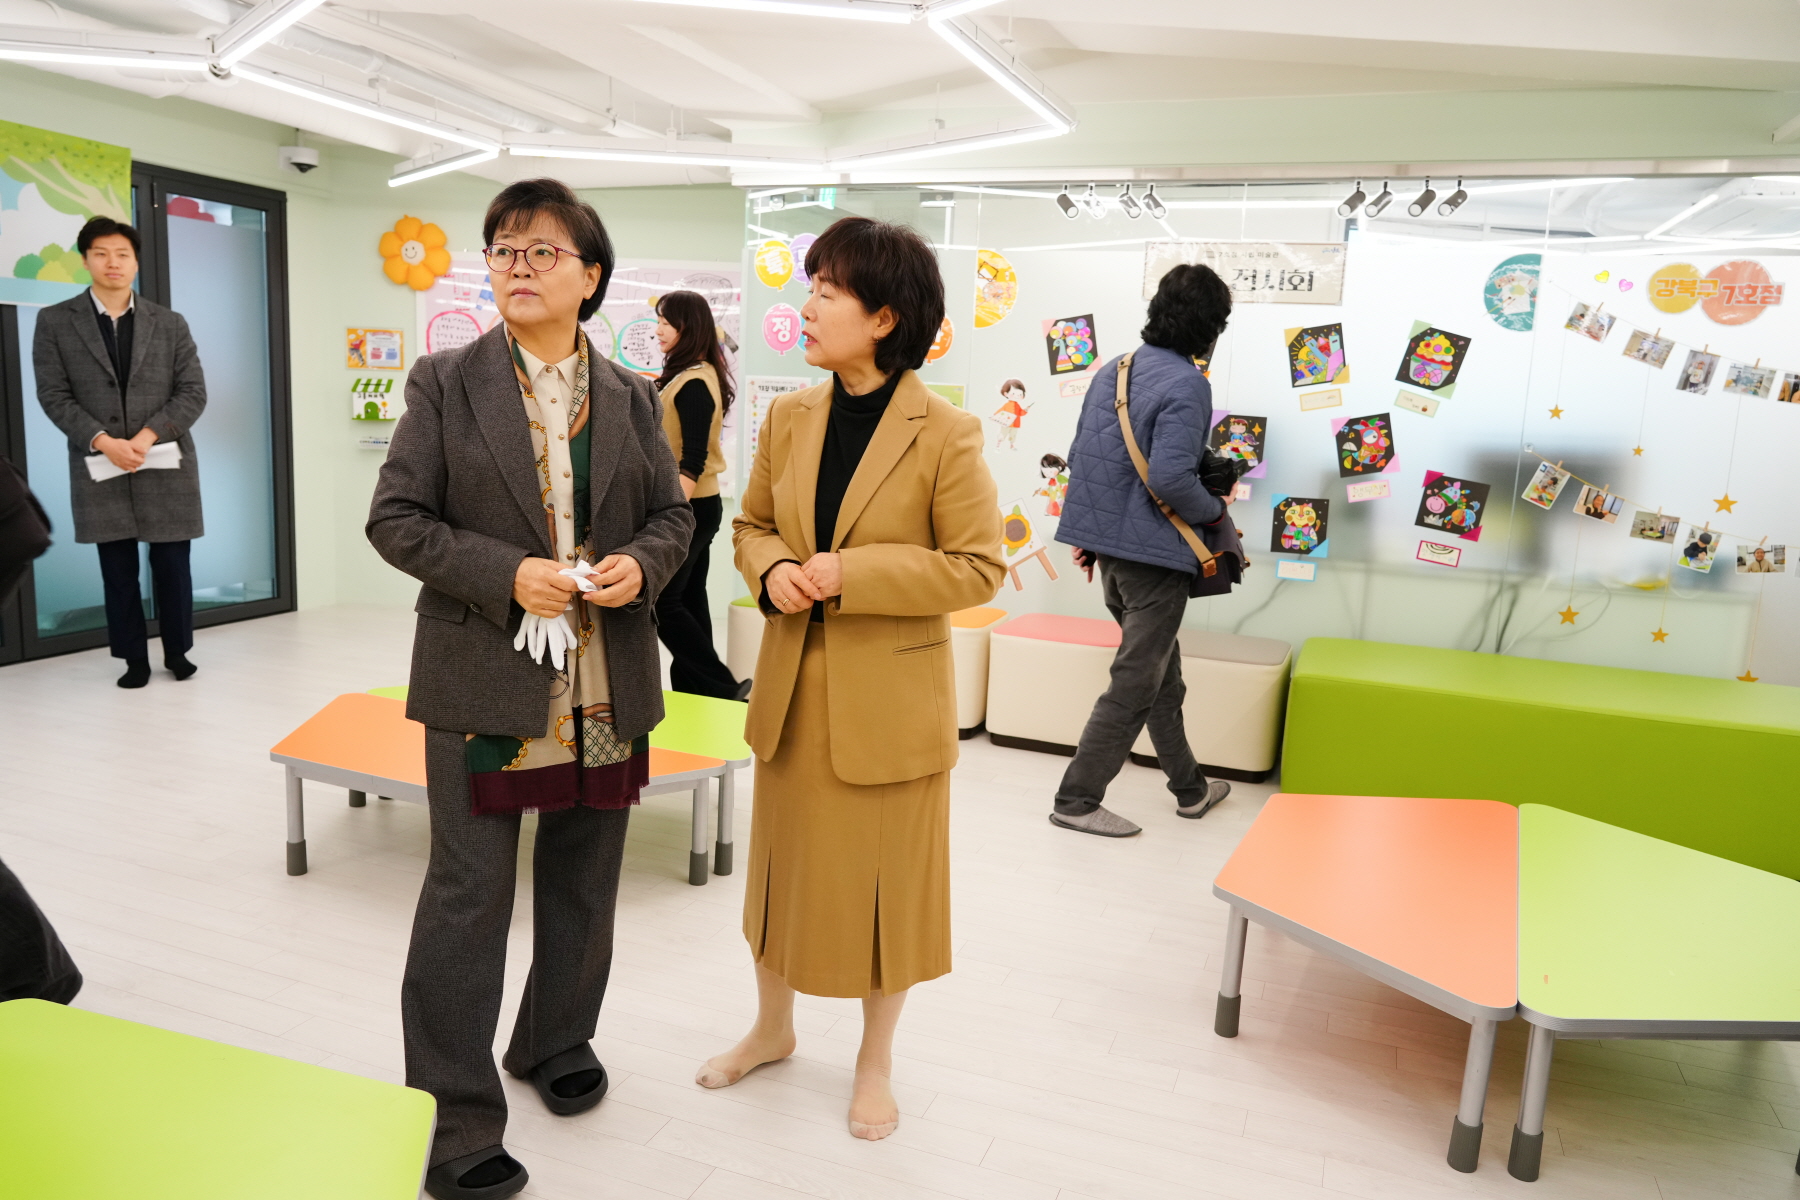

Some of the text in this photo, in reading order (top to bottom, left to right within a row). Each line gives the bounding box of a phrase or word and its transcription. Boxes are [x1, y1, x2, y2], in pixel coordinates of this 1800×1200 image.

[1655, 278, 1784, 305] 강북구 7호점
[771, 316, 791, 343] 정
